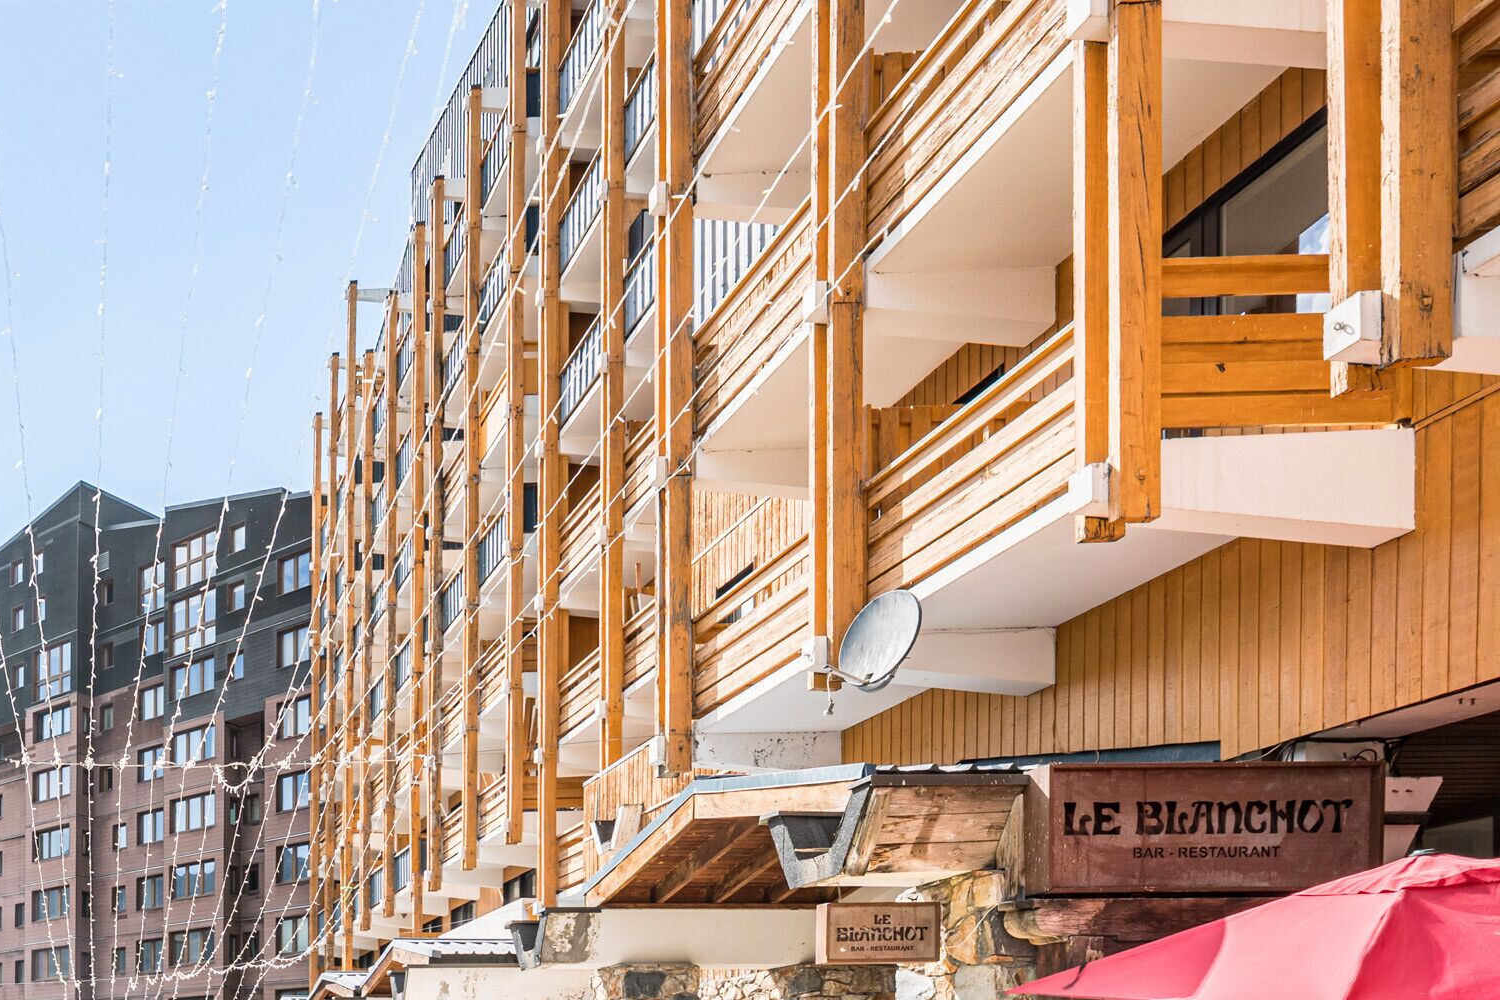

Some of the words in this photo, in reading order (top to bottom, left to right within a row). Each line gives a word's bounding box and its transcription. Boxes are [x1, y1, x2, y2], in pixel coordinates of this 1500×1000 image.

[1064, 801, 1121, 836] LE
[1135, 798, 1354, 835] BLANCHOT
[1133, 847, 1165, 859] BAR
[1178, 846, 1281, 859] RESTAURANT
[873, 914, 891, 925] LE
[836, 926, 929, 942] BLANCHOT
